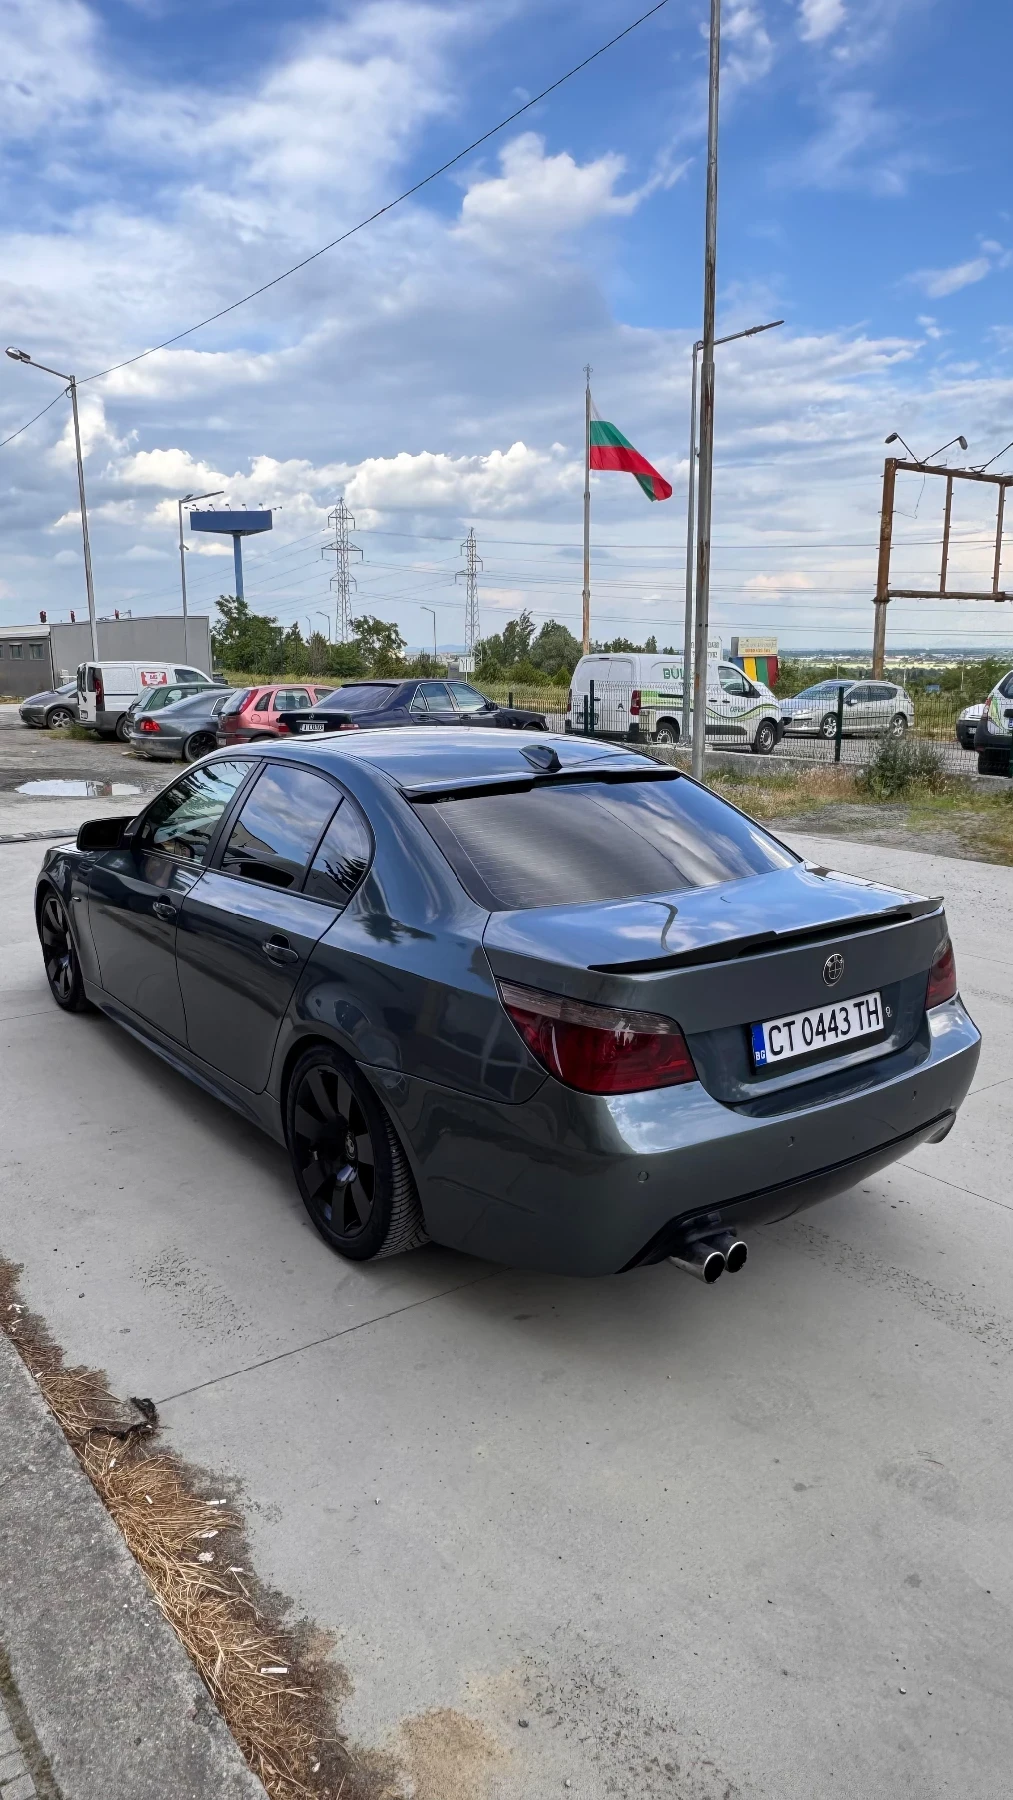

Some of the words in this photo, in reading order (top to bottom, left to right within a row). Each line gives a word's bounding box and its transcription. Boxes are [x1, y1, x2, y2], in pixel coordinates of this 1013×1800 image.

[768, 1020, 796, 1056] CT
[801, 1006, 851, 1046] 0443
[853, 997, 880, 1031] TH
[755, 1049, 766, 1061] BG
